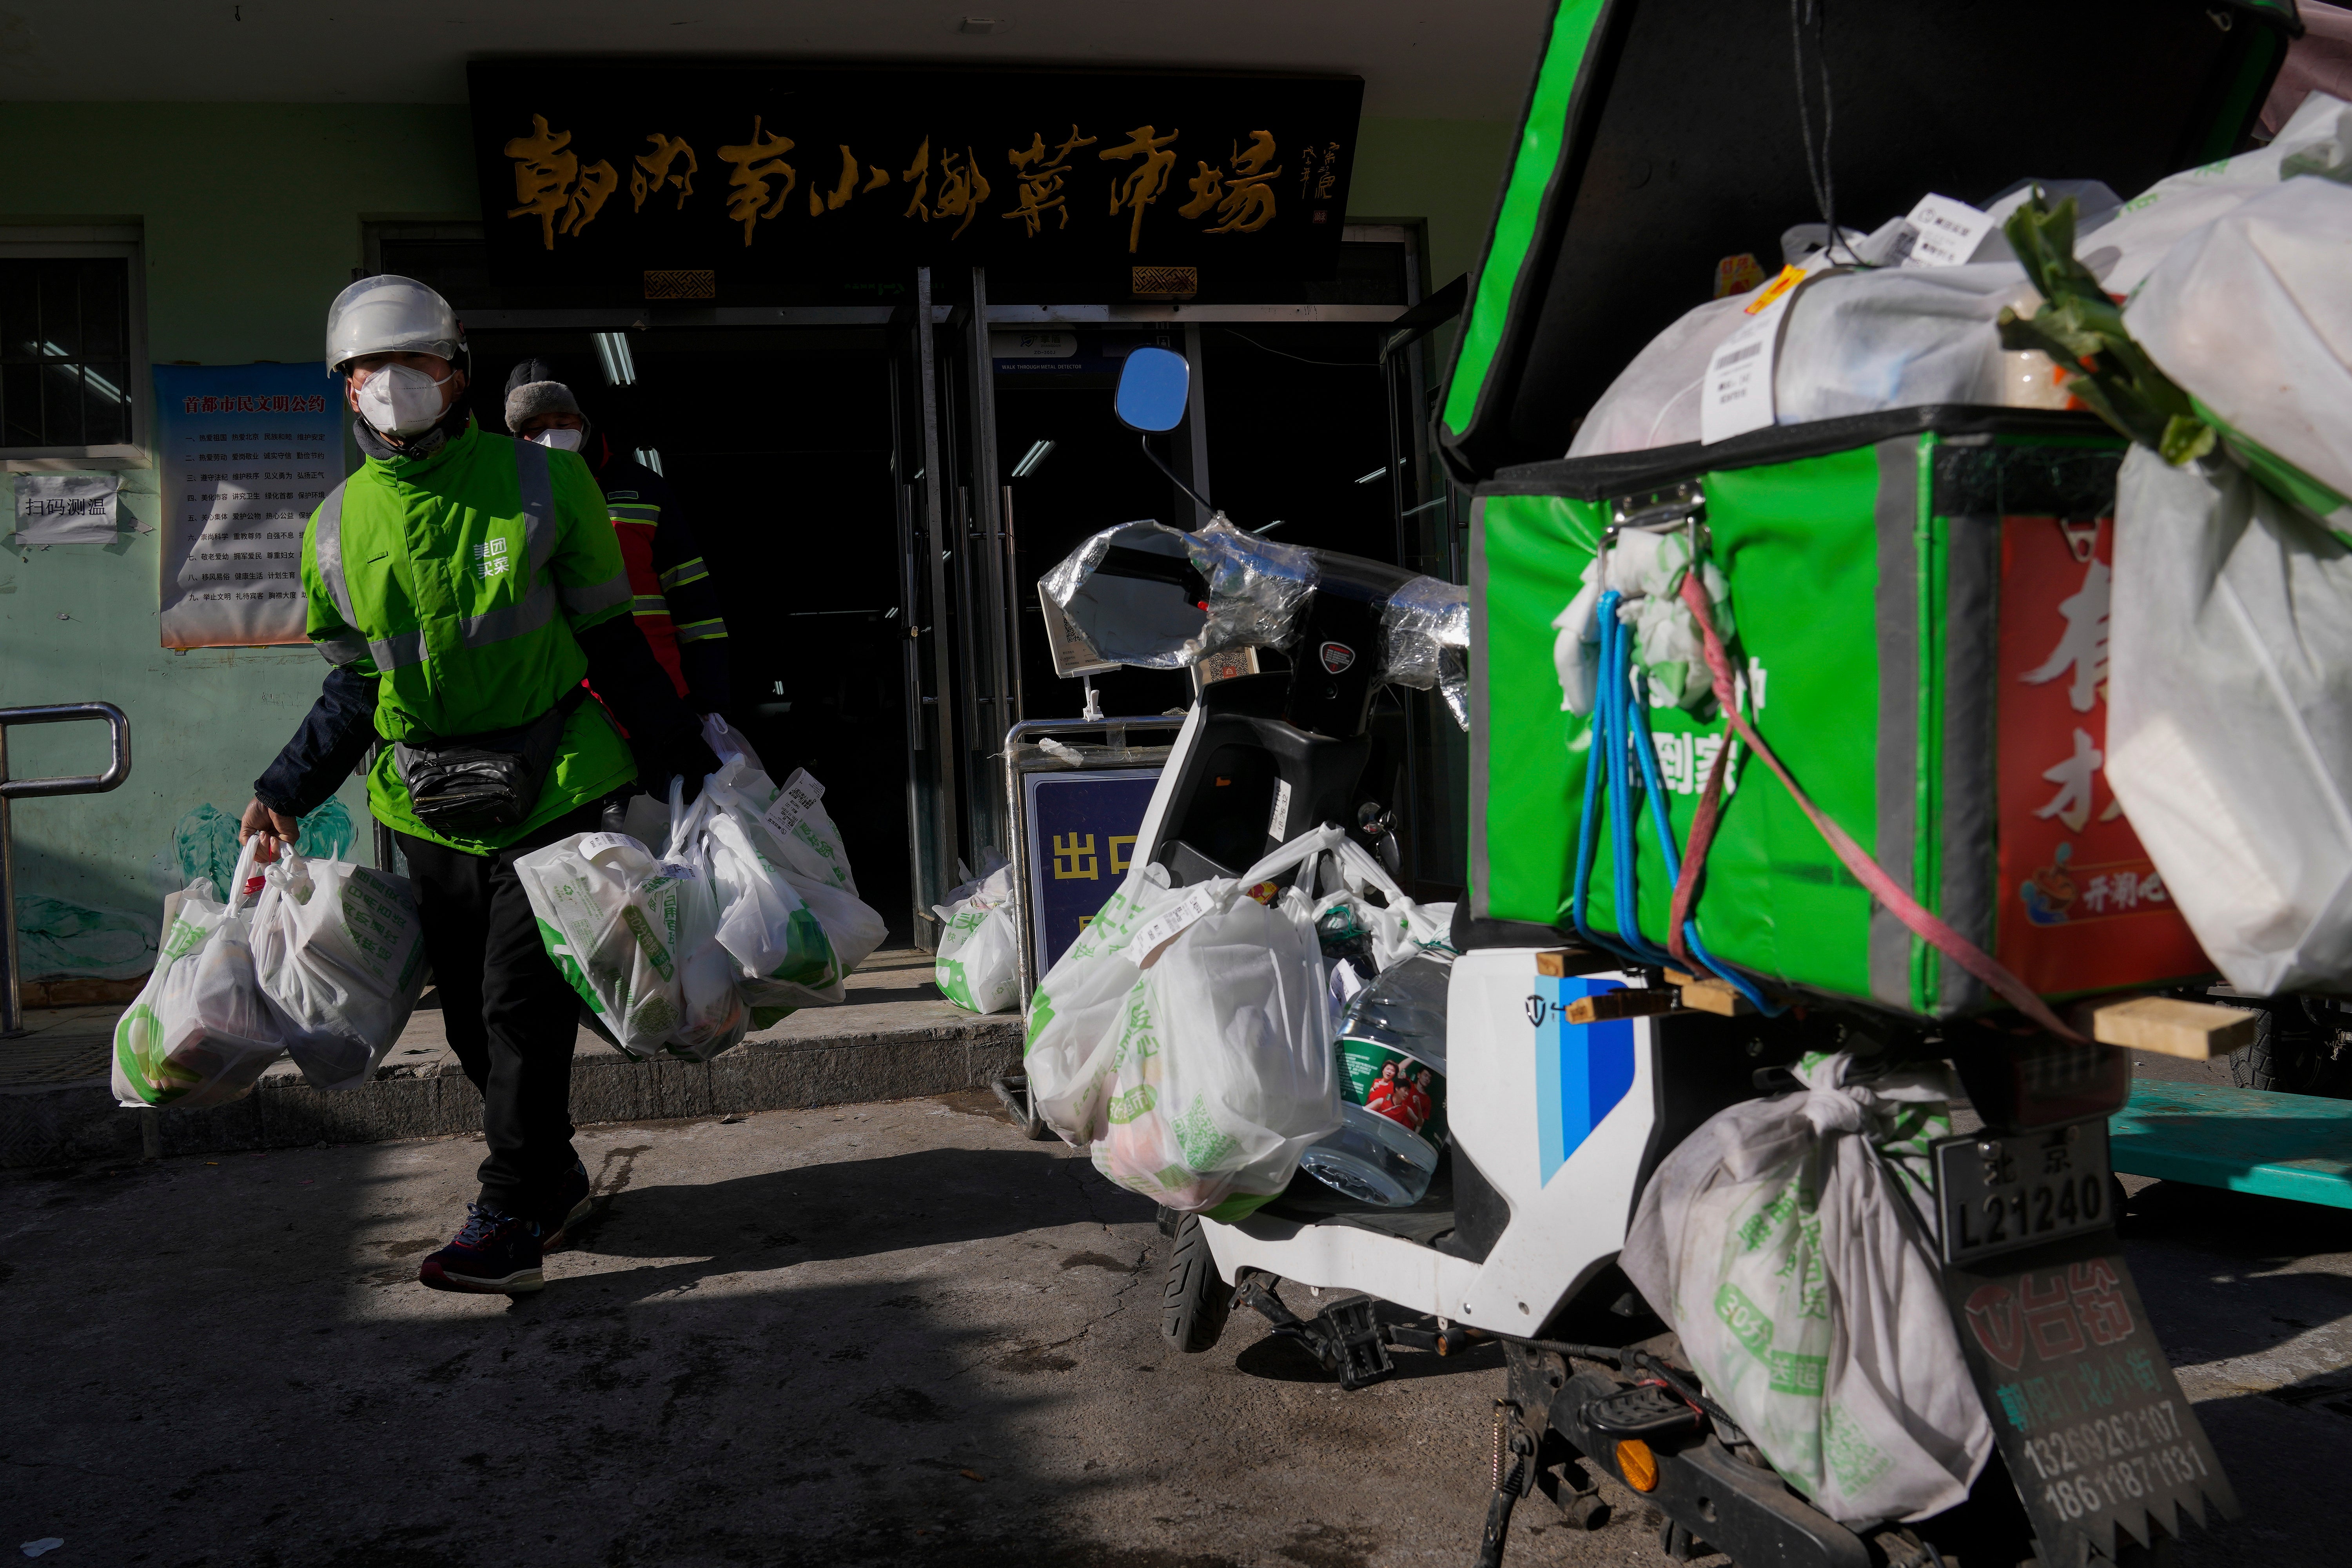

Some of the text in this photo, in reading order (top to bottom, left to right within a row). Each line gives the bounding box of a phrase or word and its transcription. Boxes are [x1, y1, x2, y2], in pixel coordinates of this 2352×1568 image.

[183, 395, 326, 414] 首都市民文明公约
[185, 434, 227, 442] 一、热爱祖国
[232, 433, 259, 441] 热爱北京
[297, 433, 325, 441] 维护安定
[232, 452, 259, 461] 爱岗敬业
[187, 473, 228, 482] 三、遵守法纪
[232, 472, 260, 480] 维护秩序
[297, 471, 325, 479] 弘扬正气
[187, 493, 228, 502] 四、美化市容
[232, 492, 260, 500] 讲究卫生
[298, 491, 325, 500] 保护环境
[25, 497, 107, 517] 扫码测温
[188, 513, 228, 522] 五、关心集体
[188, 533, 229, 541] 六、崇尚科学
[473, 537, 507, 560] 美团
[187, 553, 229, 561] 七、敬老爱幼
[477, 556, 510, 579] 买菜
[188, 572, 296, 581] 八、移风易俗 健康生活 计划生育
[189, 593, 231, 601] 九、举止文明
[236, 592, 264, 600] 礼待宾客
[269, 591, 297, 599] 胸襟大度
[1053, 832, 1138, 881] 出口
[1986, 1127, 2074, 1186] 北京
[1959, 1175, 2102, 1249] L21240
[2020, 1258, 2136, 1361] 台铃
[1996, 1348, 2163, 1432] 朝阳门北小街
